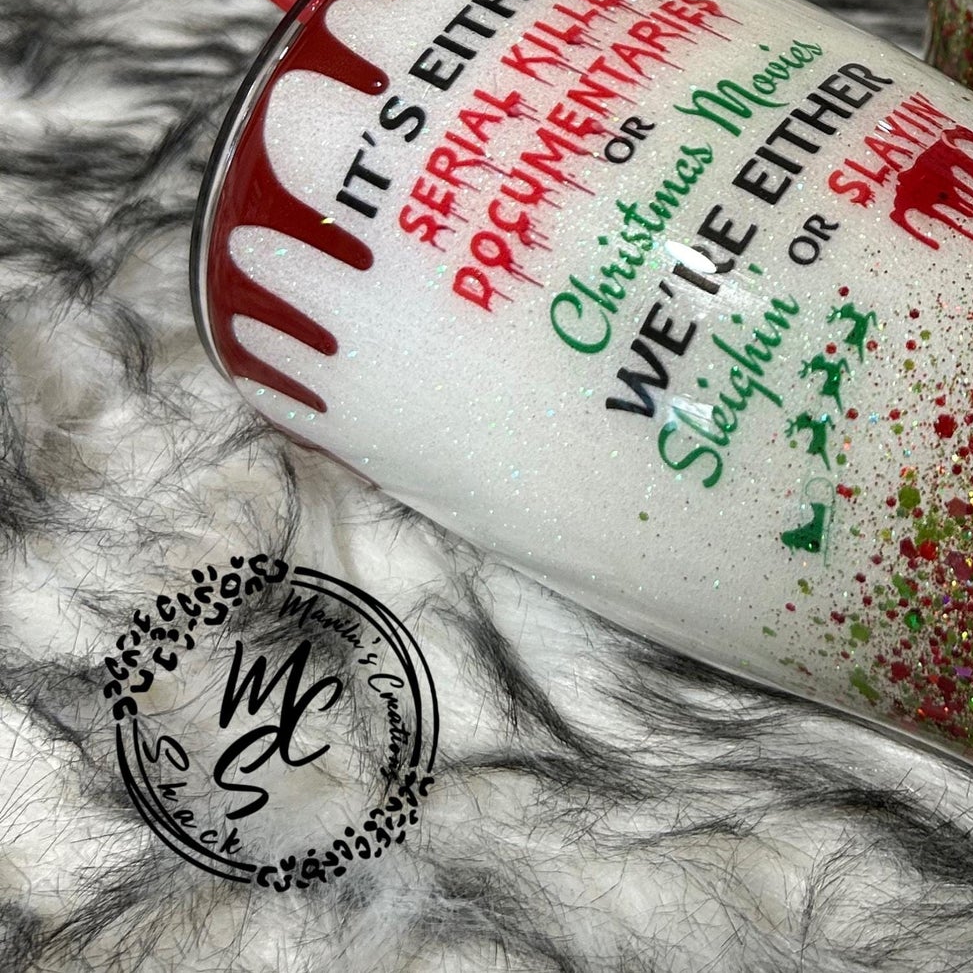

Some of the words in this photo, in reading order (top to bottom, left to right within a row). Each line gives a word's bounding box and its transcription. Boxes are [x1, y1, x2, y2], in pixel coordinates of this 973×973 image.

[335, 95, 428, 219] IT'S
[400, 86, 530, 252] SERIAL
[549, 140, 716, 356] Christmas
[673, 36, 824, 138] Movies
[603, 114, 656, 165] OR
[605, 203, 758, 419] WE'RE
[731, 61, 894, 206] EITHER
[656, 263, 801, 489] Sleighin'
[786, 213, 840, 266] OR
[828, 91, 955, 208] SLAYIN'
